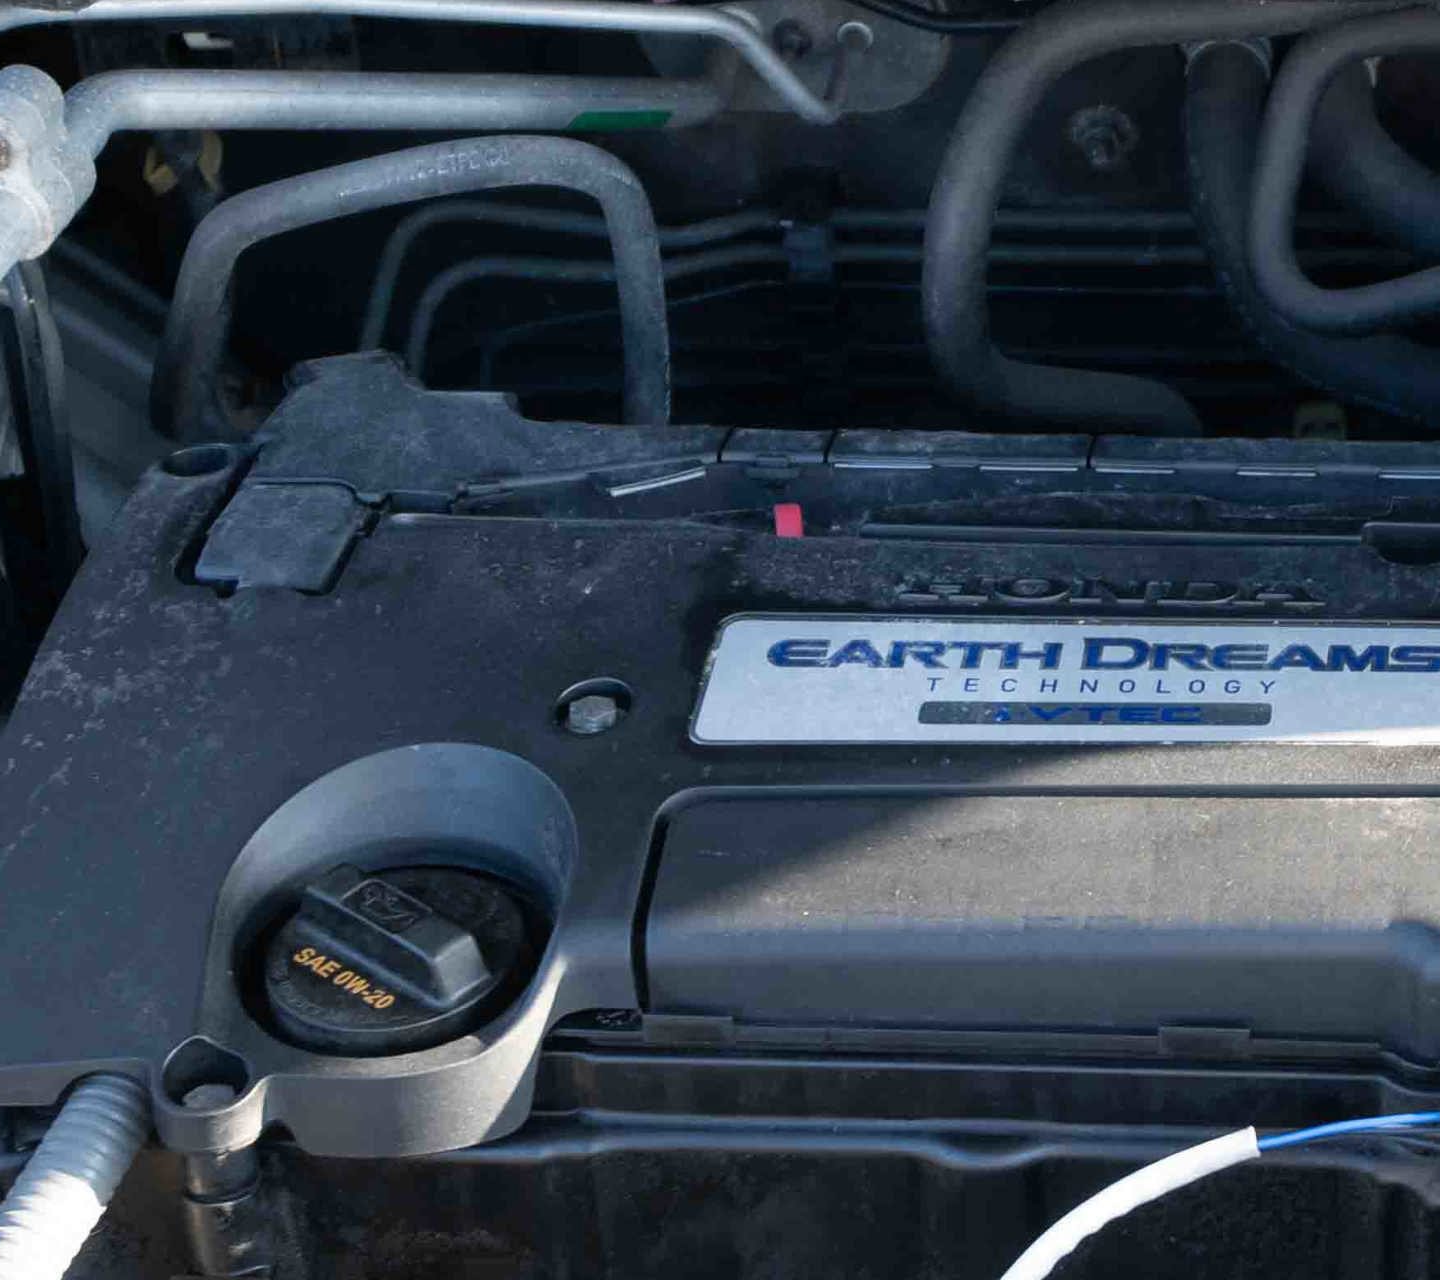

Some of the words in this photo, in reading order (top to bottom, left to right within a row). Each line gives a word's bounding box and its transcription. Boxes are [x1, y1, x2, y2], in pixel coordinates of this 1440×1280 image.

[766, 638, 1064, 671] EARTH
[926, 677, 1277, 695] TECHNOLOGY
[293, 948, 341, 978] SAE
[333, 971, 396, 1009] 0W-20
